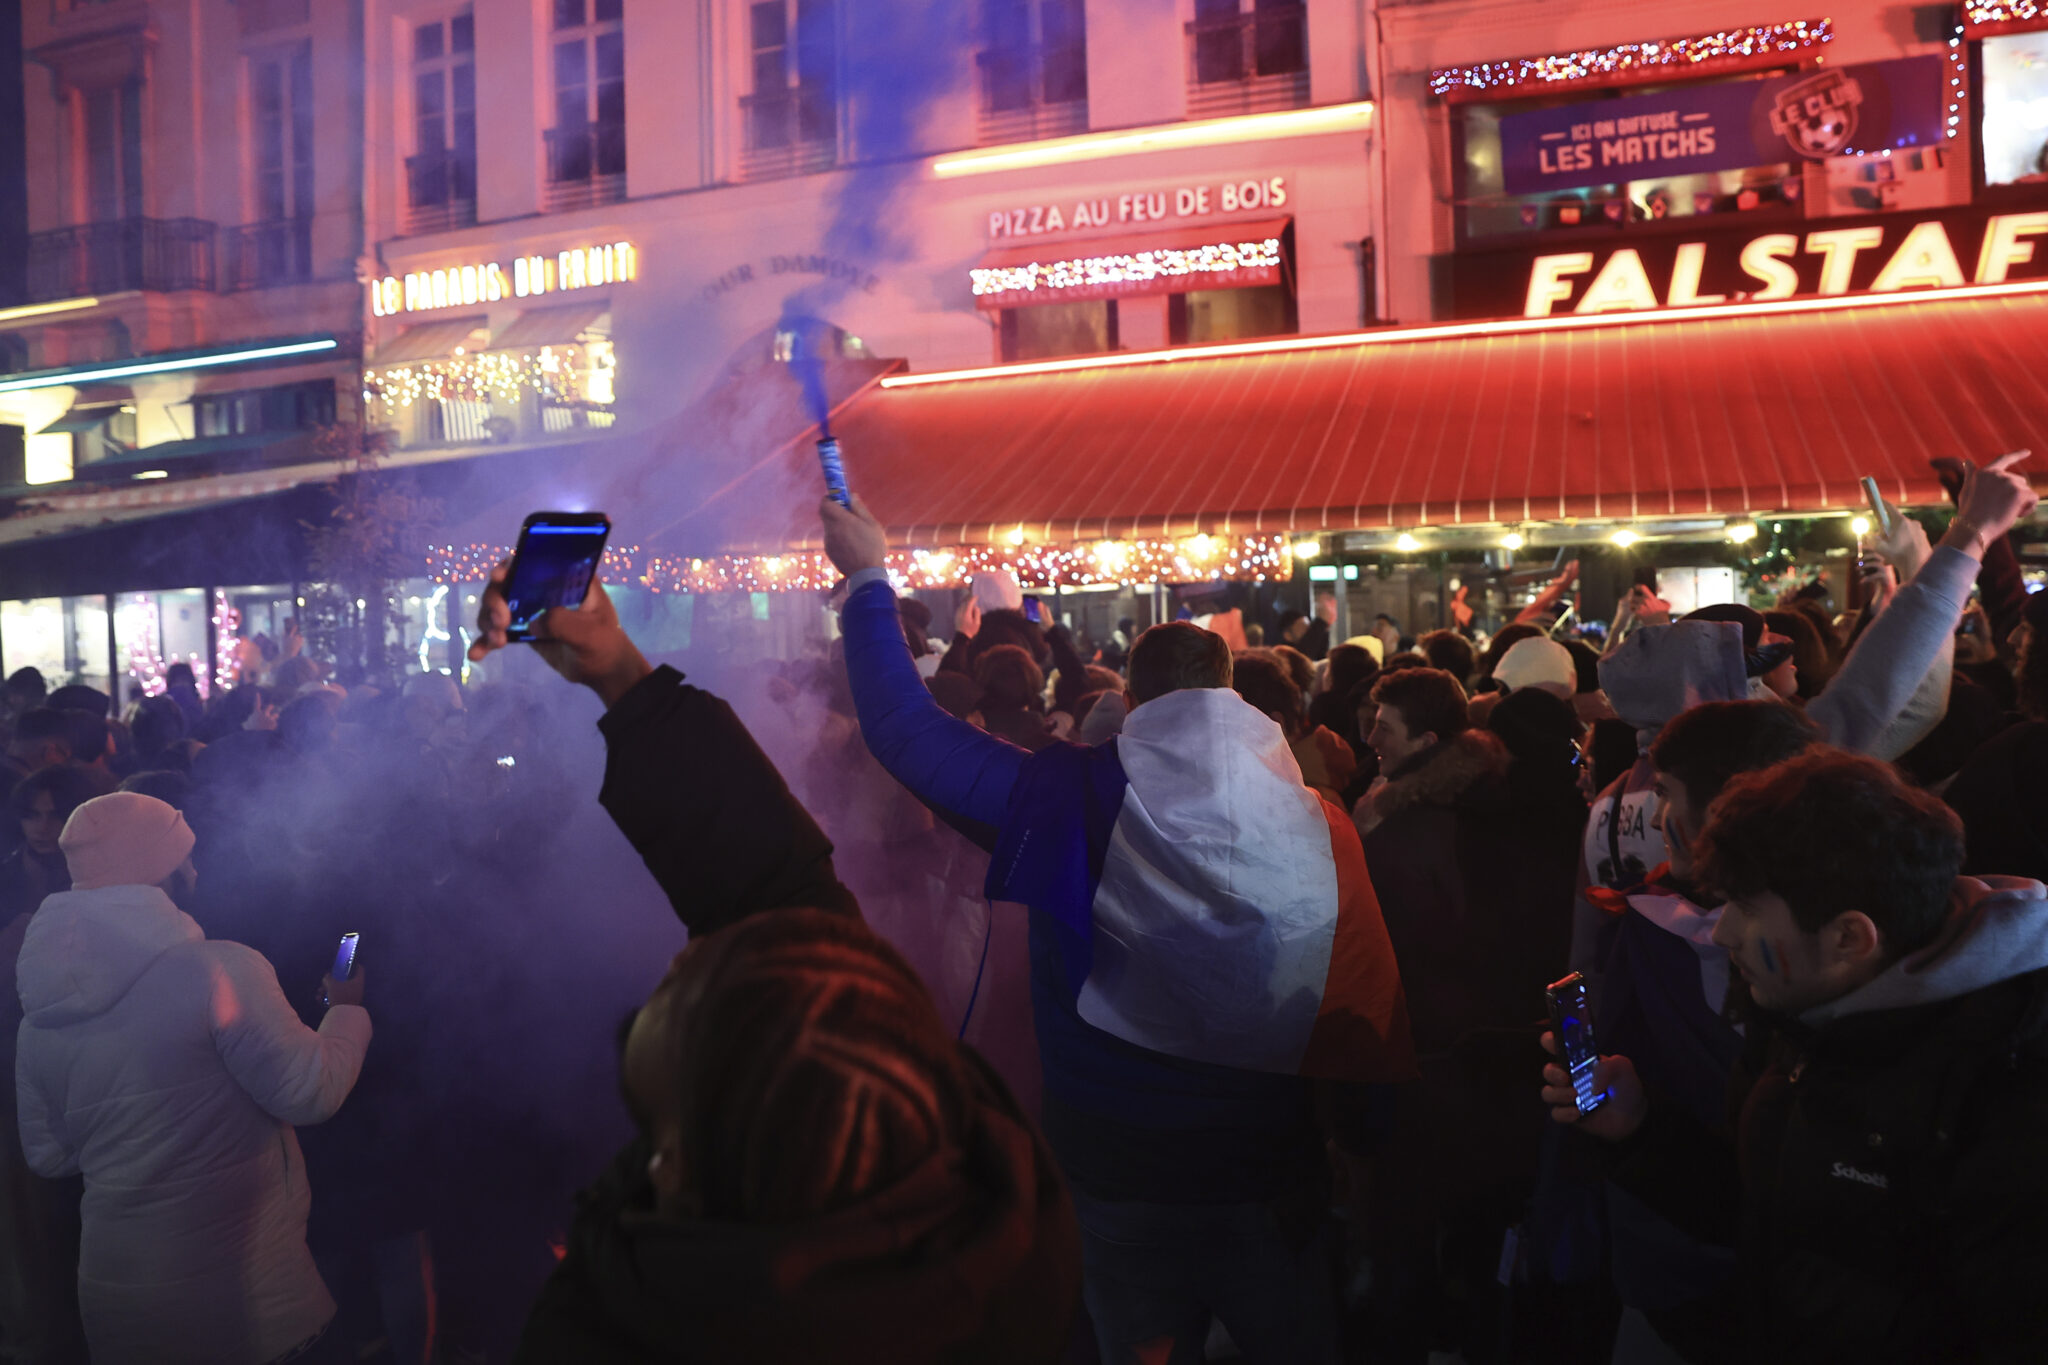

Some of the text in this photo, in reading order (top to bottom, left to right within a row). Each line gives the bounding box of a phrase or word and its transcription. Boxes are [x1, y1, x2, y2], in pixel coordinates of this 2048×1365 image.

[1539, 126, 1716, 175] LES MATCHS
[1570, 110, 1680, 142] ICI ON DIFFUSE
[989, 176, 1287, 238] PIZZA AU FEU DE BOIS
[371, 241, 635, 318] LE PARADIS DU FRUIT
